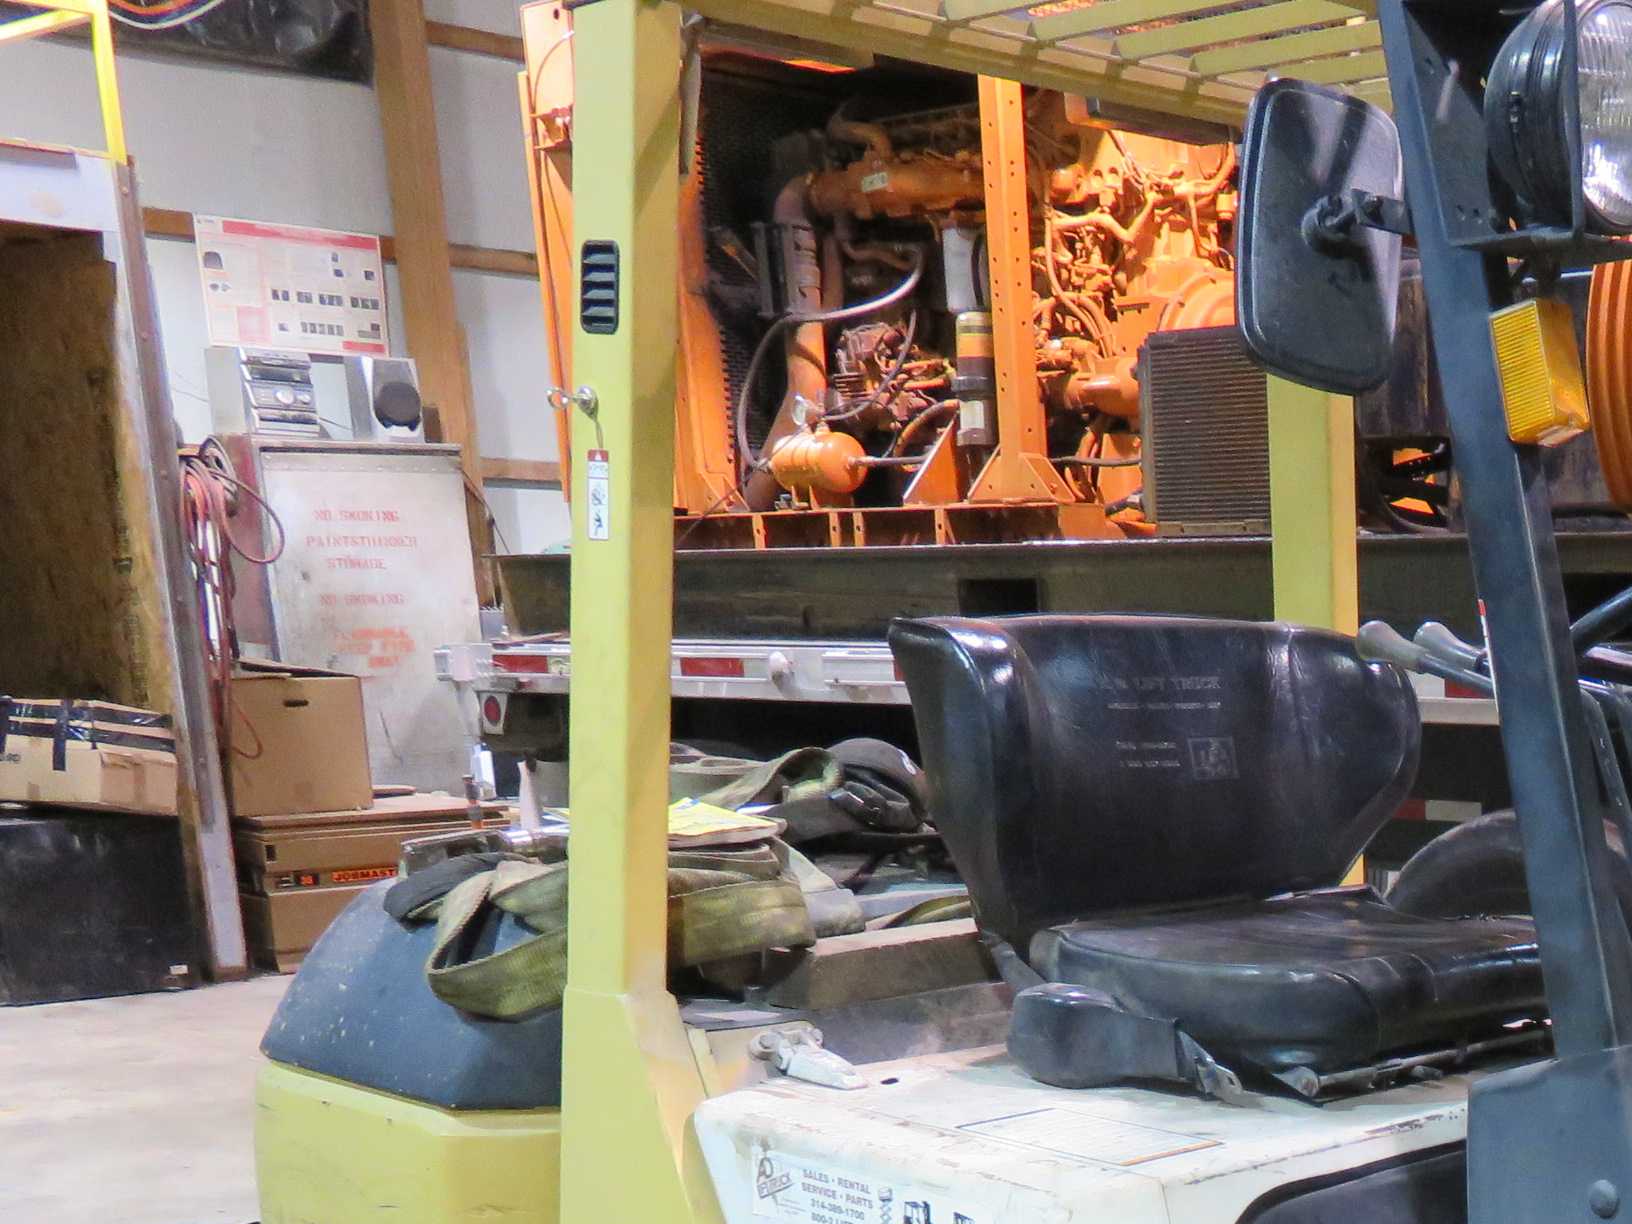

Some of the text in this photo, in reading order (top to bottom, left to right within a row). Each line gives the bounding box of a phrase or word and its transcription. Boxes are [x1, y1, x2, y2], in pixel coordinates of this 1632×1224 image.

[313, 509, 400, 522] NO SMOKING
[319, 593, 405, 606] NO SMOKING
[335, 868, 397, 881] JOBMAST
[803, 1169, 871, 1194] SALES RENTAL
[801, 1182, 837, 1200] SERVICE
[845, 1193, 874, 1209] PARTS
